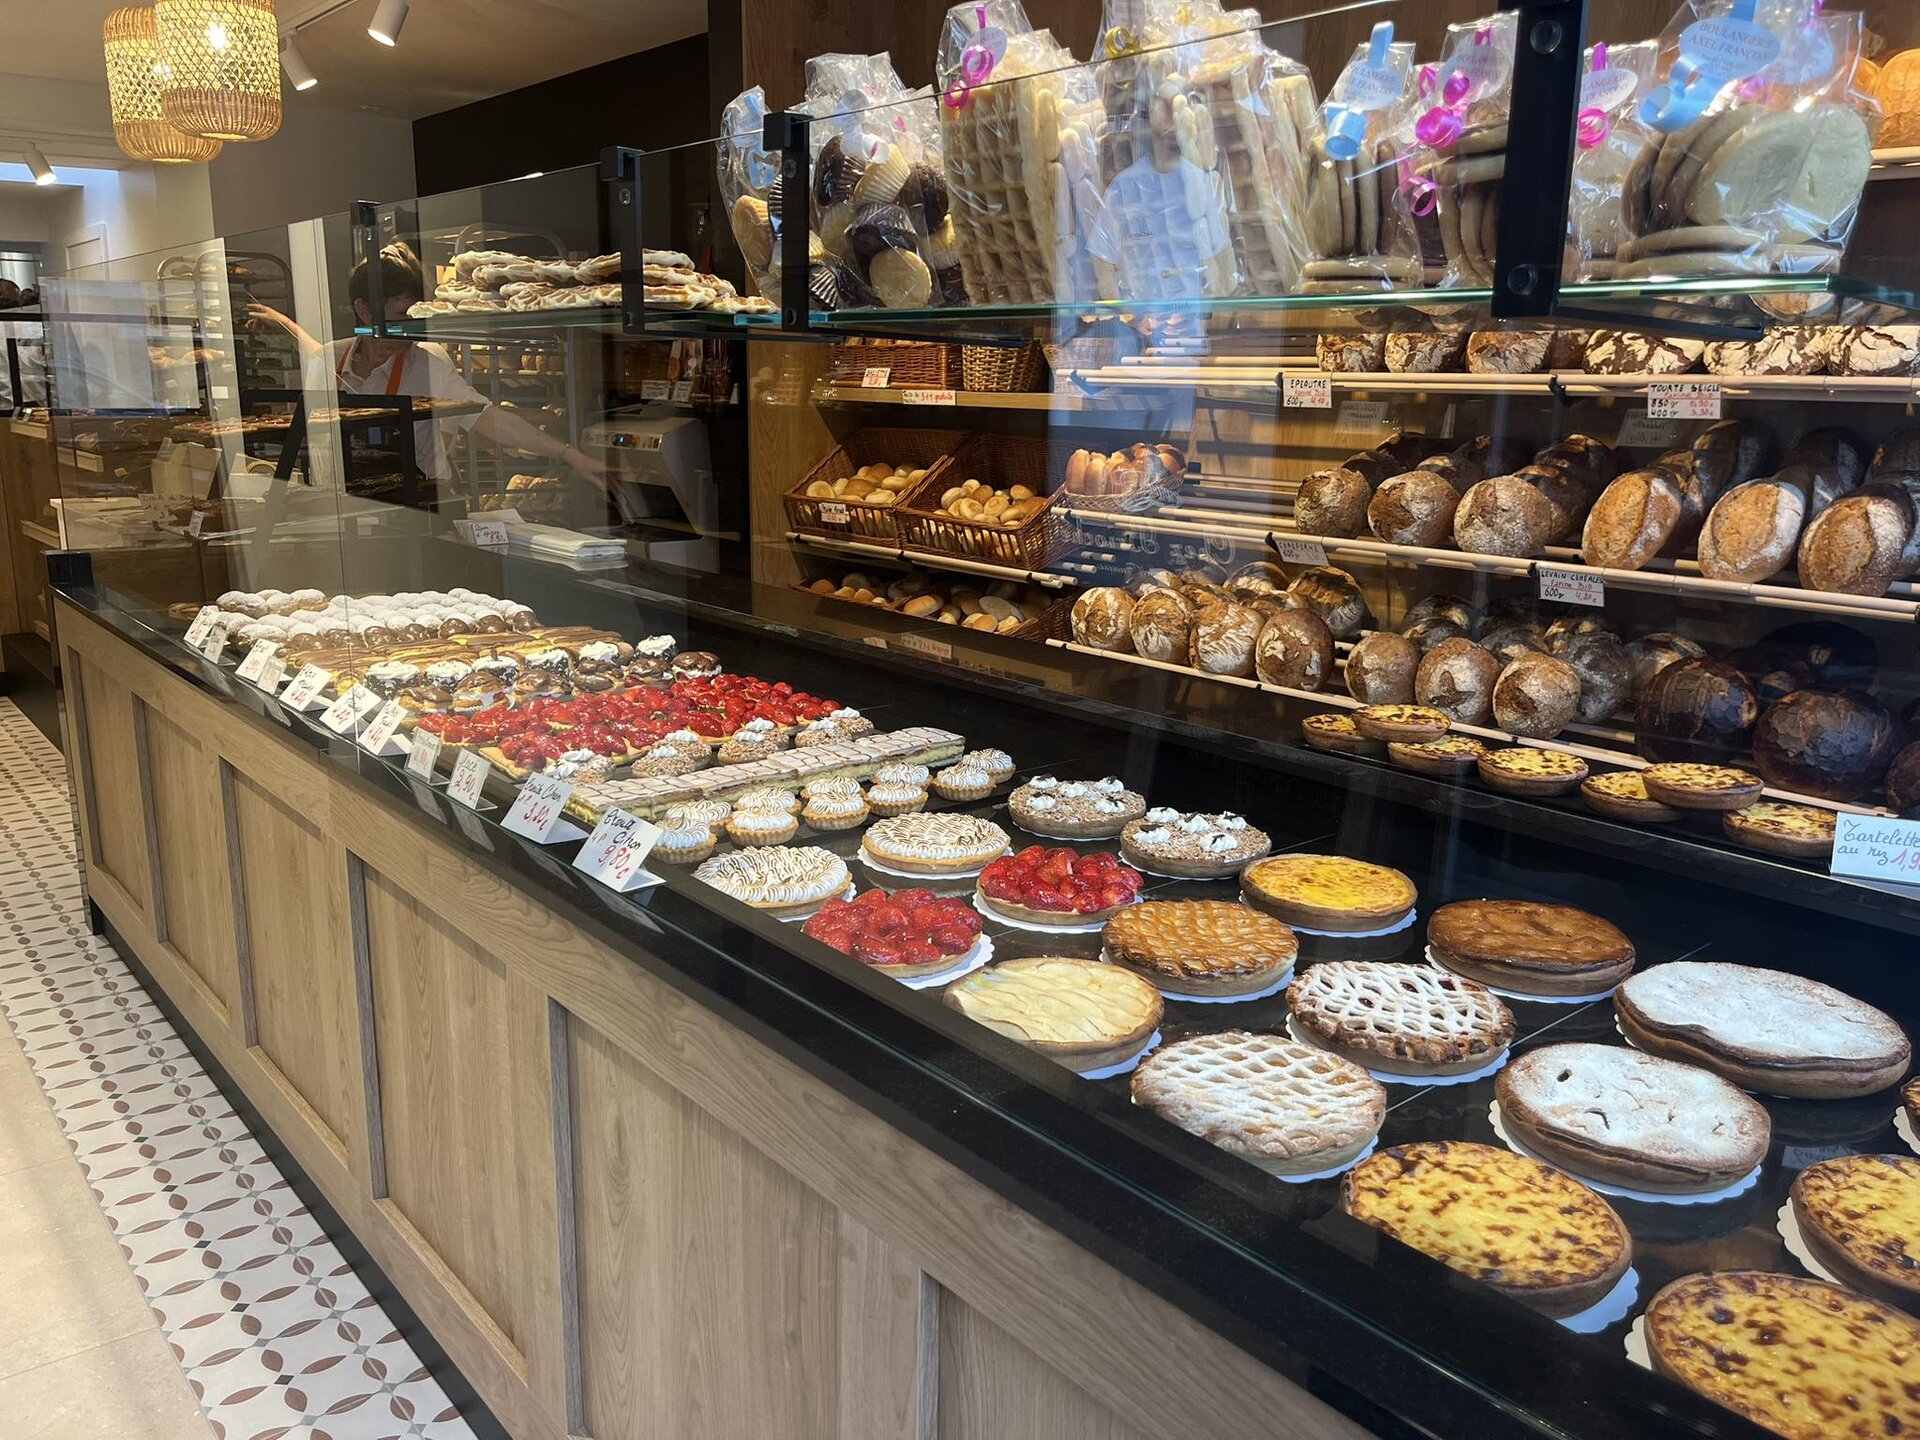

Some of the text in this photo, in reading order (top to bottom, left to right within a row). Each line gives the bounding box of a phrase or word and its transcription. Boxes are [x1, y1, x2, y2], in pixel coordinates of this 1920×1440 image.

[1689, 33, 1717, 50] AXEL
[1700, 21, 1775, 48] BOULANGERIE
[1290, 378, 1327, 389] EPEAUTRE
[1651, 384, 1684, 392] TOURTE
[1541, 570, 1567, 579] LEVAIN
[1837, 845, 1859, 854] au
[1867, 846, 1889, 866] riz
